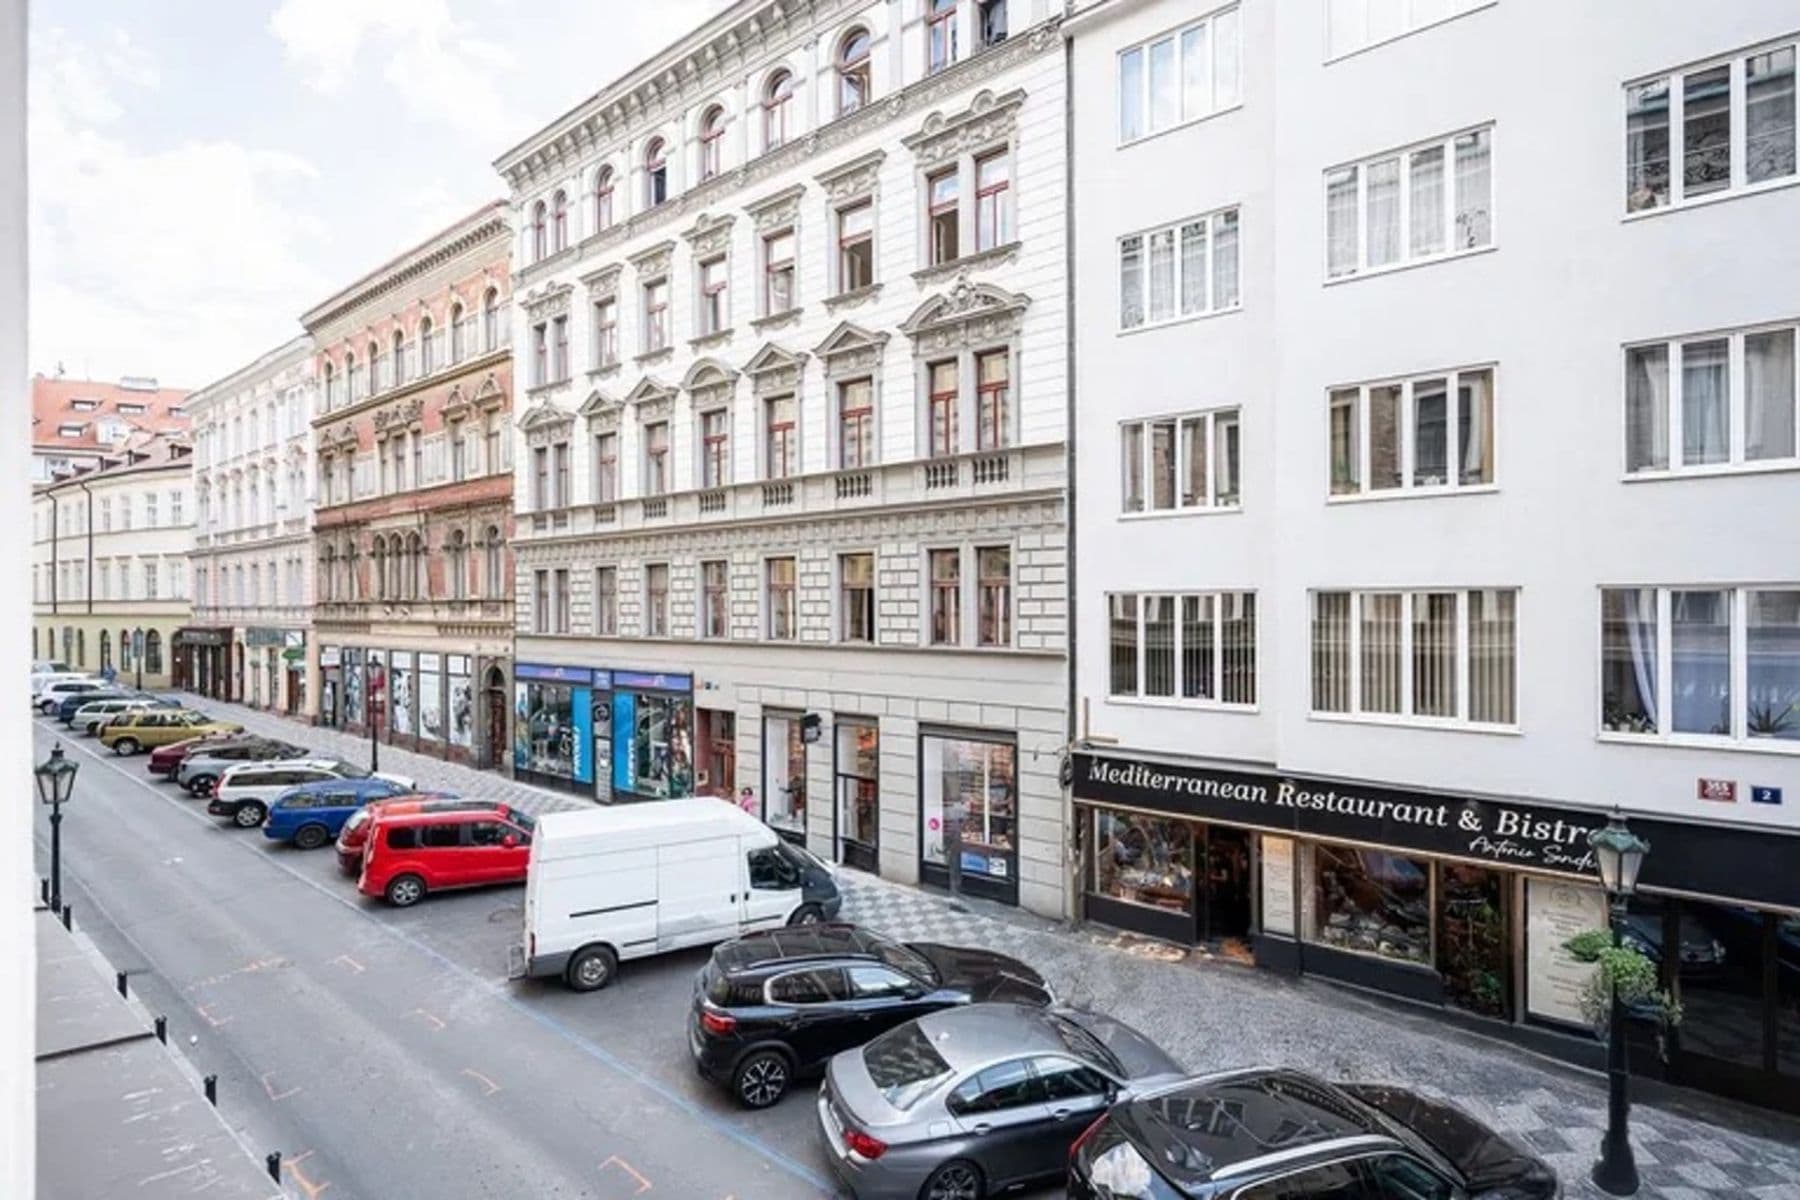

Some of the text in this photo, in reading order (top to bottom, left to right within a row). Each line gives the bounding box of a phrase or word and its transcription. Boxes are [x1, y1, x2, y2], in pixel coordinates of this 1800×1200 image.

[1089, 762, 1267, 803] Mediterranean
[1275, 783, 1448, 827] Restaurant
[1458, 809, 1482, 831] &
[1762, 790, 1771, 800] 2
